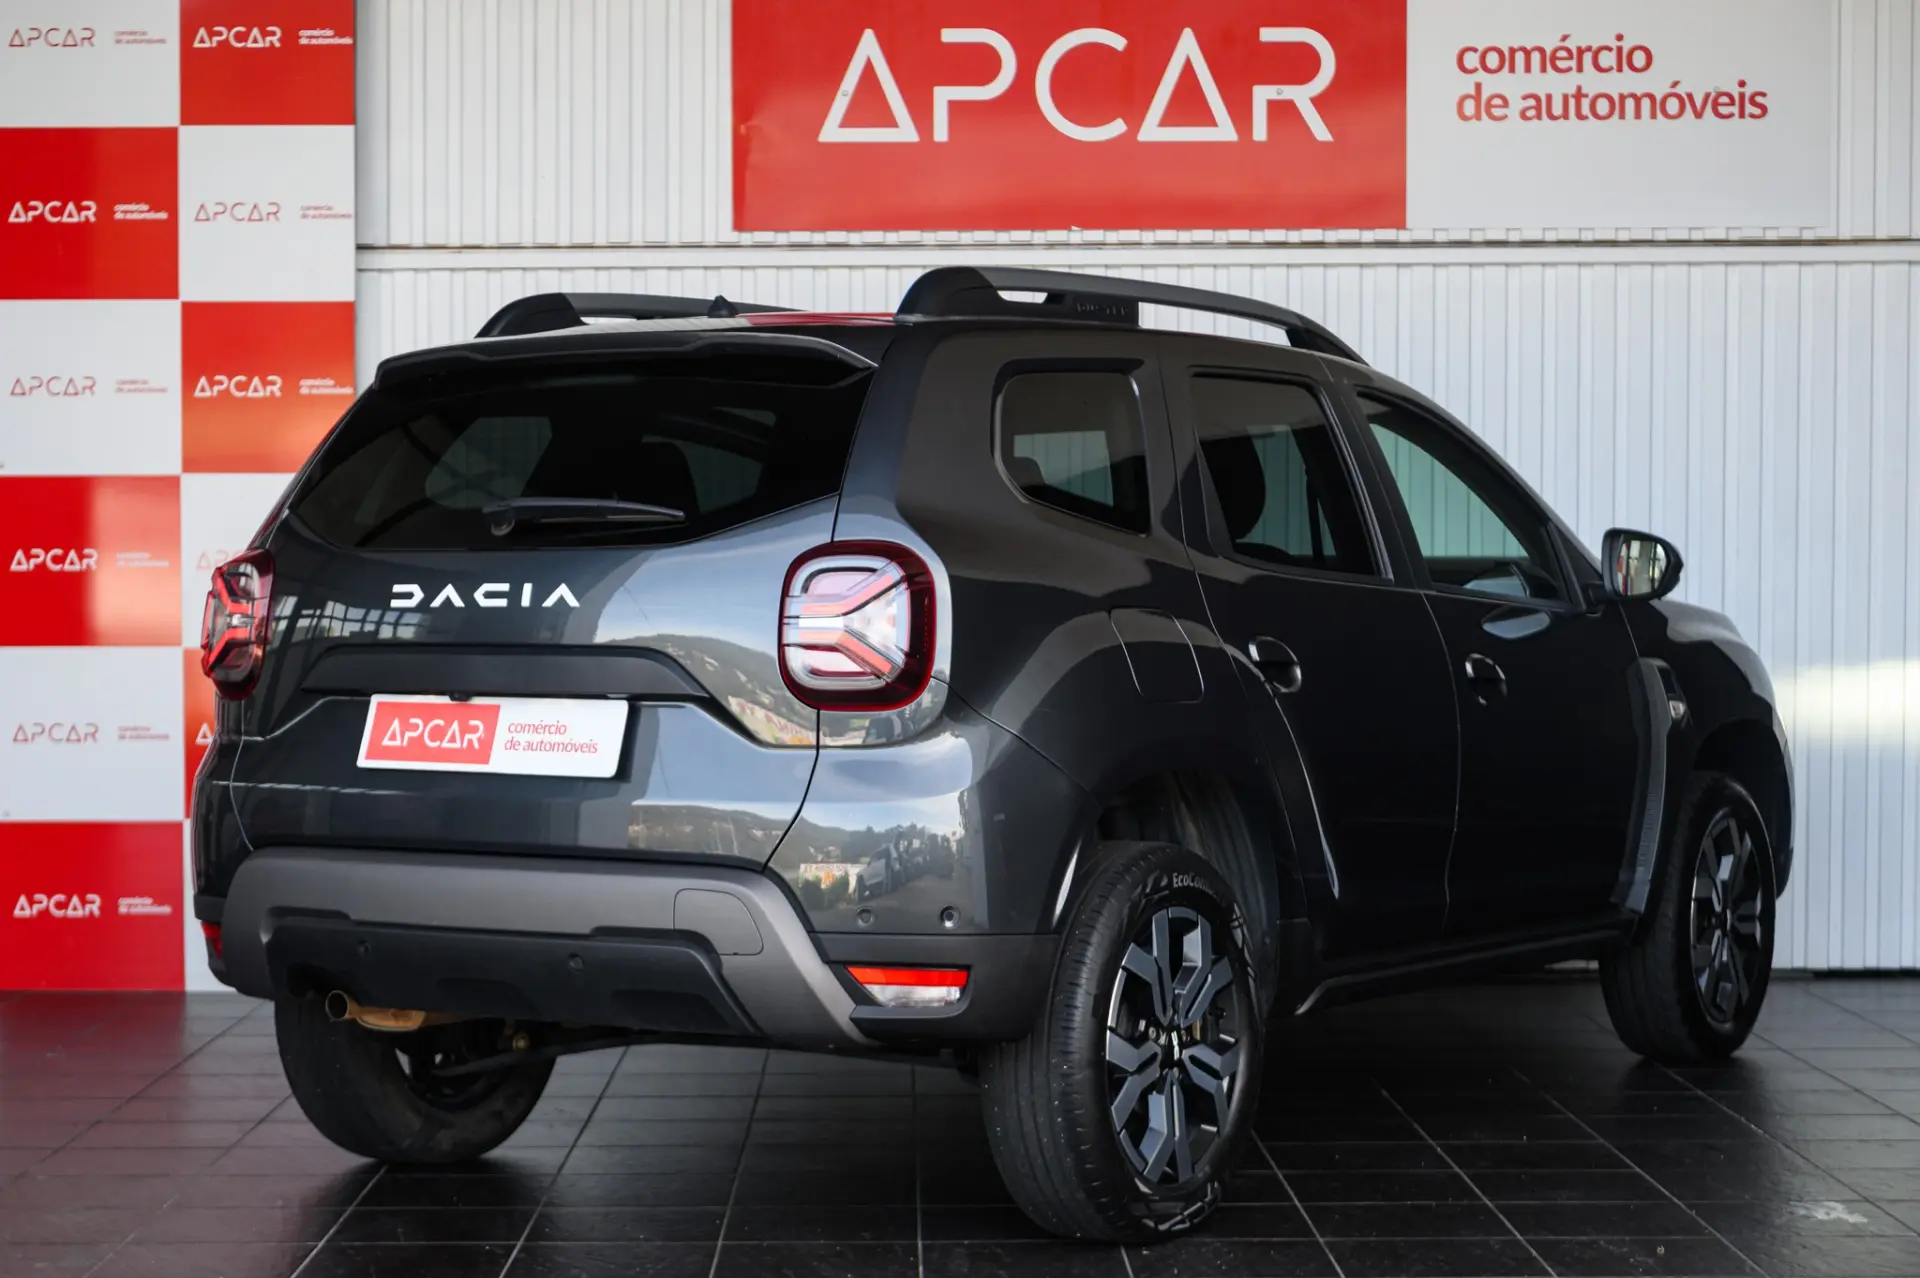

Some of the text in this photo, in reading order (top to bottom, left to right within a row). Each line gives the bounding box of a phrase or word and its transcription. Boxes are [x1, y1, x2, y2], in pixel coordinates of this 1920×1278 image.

[8, 28, 95, 47] APCAR
[193, 26, 281, 48] APCAR
[1456, 33, 1653, 74] comércio
[818, 27, 1336, 143] APCAR
[1456, 80, 1768, 121] de automóveis
[8, 201, 97, 223] APCAR
[194, 202, 281, 222] APCAR
[10, 376, 96, 396] APCAR
[194, 376, 282, 398] APCAR
[10, 549, 98, 572] APCAR
[390, 583, 580, 608] DACIA
[13, 723, 99, 744] APCAR
[382, 718, 484, 750] APCAR
[508, 720, 567, 735] comércio
[504, 737, 598, 754] de automóveis
[13, 894, 101, 918] APCAR
